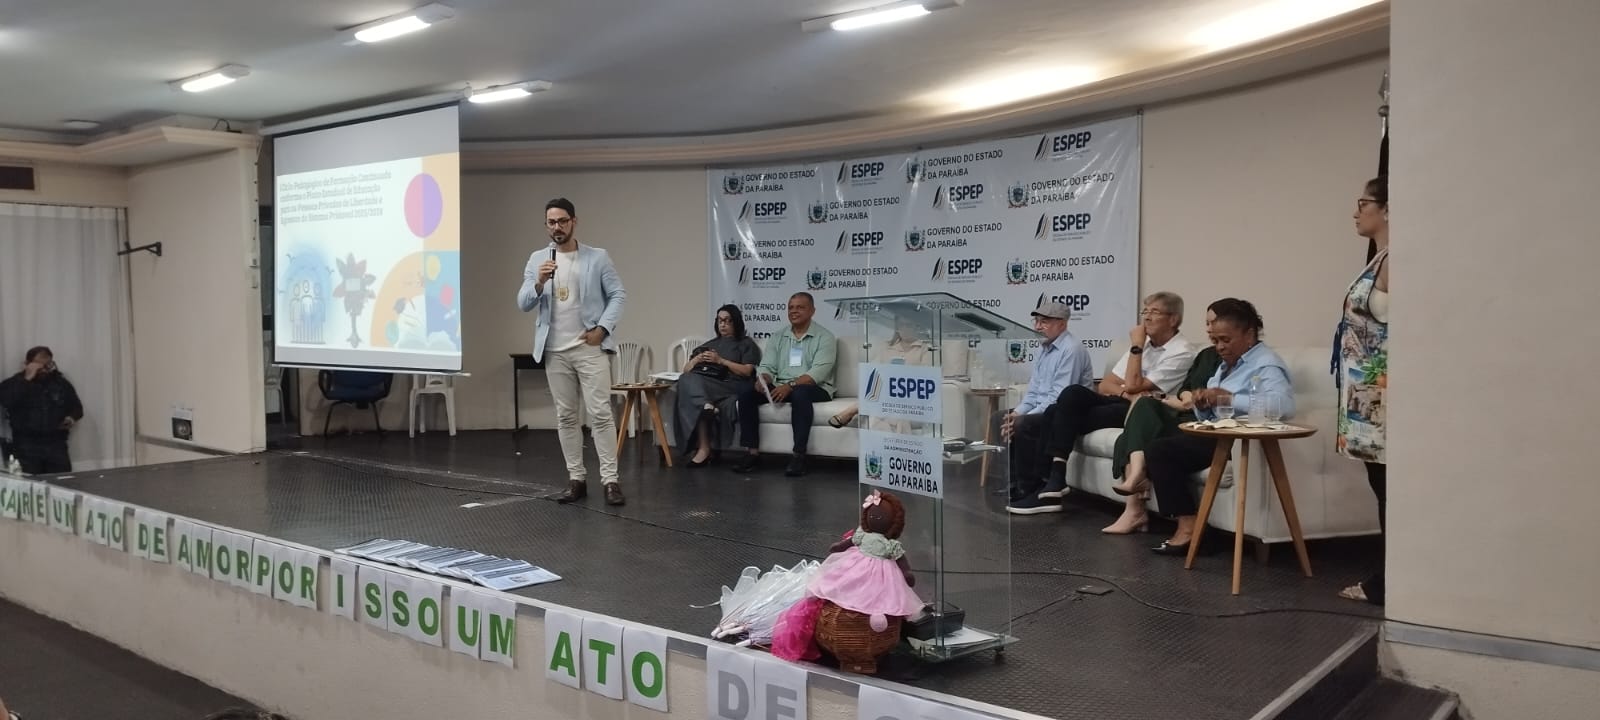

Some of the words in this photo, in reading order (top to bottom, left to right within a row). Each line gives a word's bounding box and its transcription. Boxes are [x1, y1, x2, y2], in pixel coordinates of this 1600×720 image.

[1053, 131, 1091, 152] ESPEP
[928, 156, 962, 167] GOVERNO
[964, 153, 974, 163] DO
[975, 149, 1003, 161] ESTADO
[745, 172, 777, 182] GOVERNO
[779, 172, 788, 180] DO
[790, 170, 815, 179] ESTADO
[851, 161, 884, 178] ESPEP
[928, 171, 937, 180] DA
[938, 167, 969, 179] PARAÍBA
[745, 185, 754, 193] DA
[756, 183, 784, 192] PARAÍBA
[1031, 179, 1069, 191] GOVERNO
[1070, 176, 1081, 187] DO
[949, 183, 984, 202] ESPEP
[1030, 196, 1041, 205] DA
[1042, 191, 1074, 204] PARAÍBA
[754, 202, 787, 216] ESPEP
[829, 200, 861, 210] GOVERNO
[863, 199, 872, 207] DO
[873, 197, 900, 206] ESTADO
[829, 213, 838, 221] DA
[840, 211, 869, 220] PARAÍBA
[1053, 213, 1091, 232] ESPEP
[927, 226, 961, 236] GOVERNO
[962, 224, 973, 234] DO
[974, 222, 1002, 233] ESTADO
[789, 239, 815, 247] ESTADO
[851, 231, 884, 247] ESPEP
[926, 241, 936, 249] DA
[937, 238, 967, 248] PARAÍBA
[948, 258, 982, 275] ESPEP
[1030, 258, 1066, 269] GOVERNO
[1068, 257, 1079, 267] DO
[1081, 254, 1115, 266] ESTADO
[752, 267, 786, 281] ESPEP
[828, 268, 861, 277] GOVERNO
[862, 267, 872, 276] DO
[872, 266, 898, 275] ESTADO
[1030, 273, 1040, 282] DA
[1041, 270, 1074, 282] PARAÍBA
[828, 280, 837, 288] DA
[838, 277, 867, 288] PARAÍBA
[744, 303, 775, 311] GOVERNO
[776, 303, 786, 311] DO
[973, 299, 1001, 308] ESTADO
[744, 314, 752, 322] DA
[752, 313, 781, 322] PARAÍBA
[889, 377, 936, 400] ESPEP
[889, 457, 932, 476] GOVERNO
[889, 473, 900, 487] DA
[901, 475, 939, 494] PARAÍBA
[85, 509, 122, 543] ATO
[138, 523, 166, 556] DE
[178, 534, 249, 582] AMOR
[257, 554, 316, 602] POR
[457, 605, 515, 659] UM
[550, 631, 664, 698] ATO
[718, 670, 797, 720] DE
